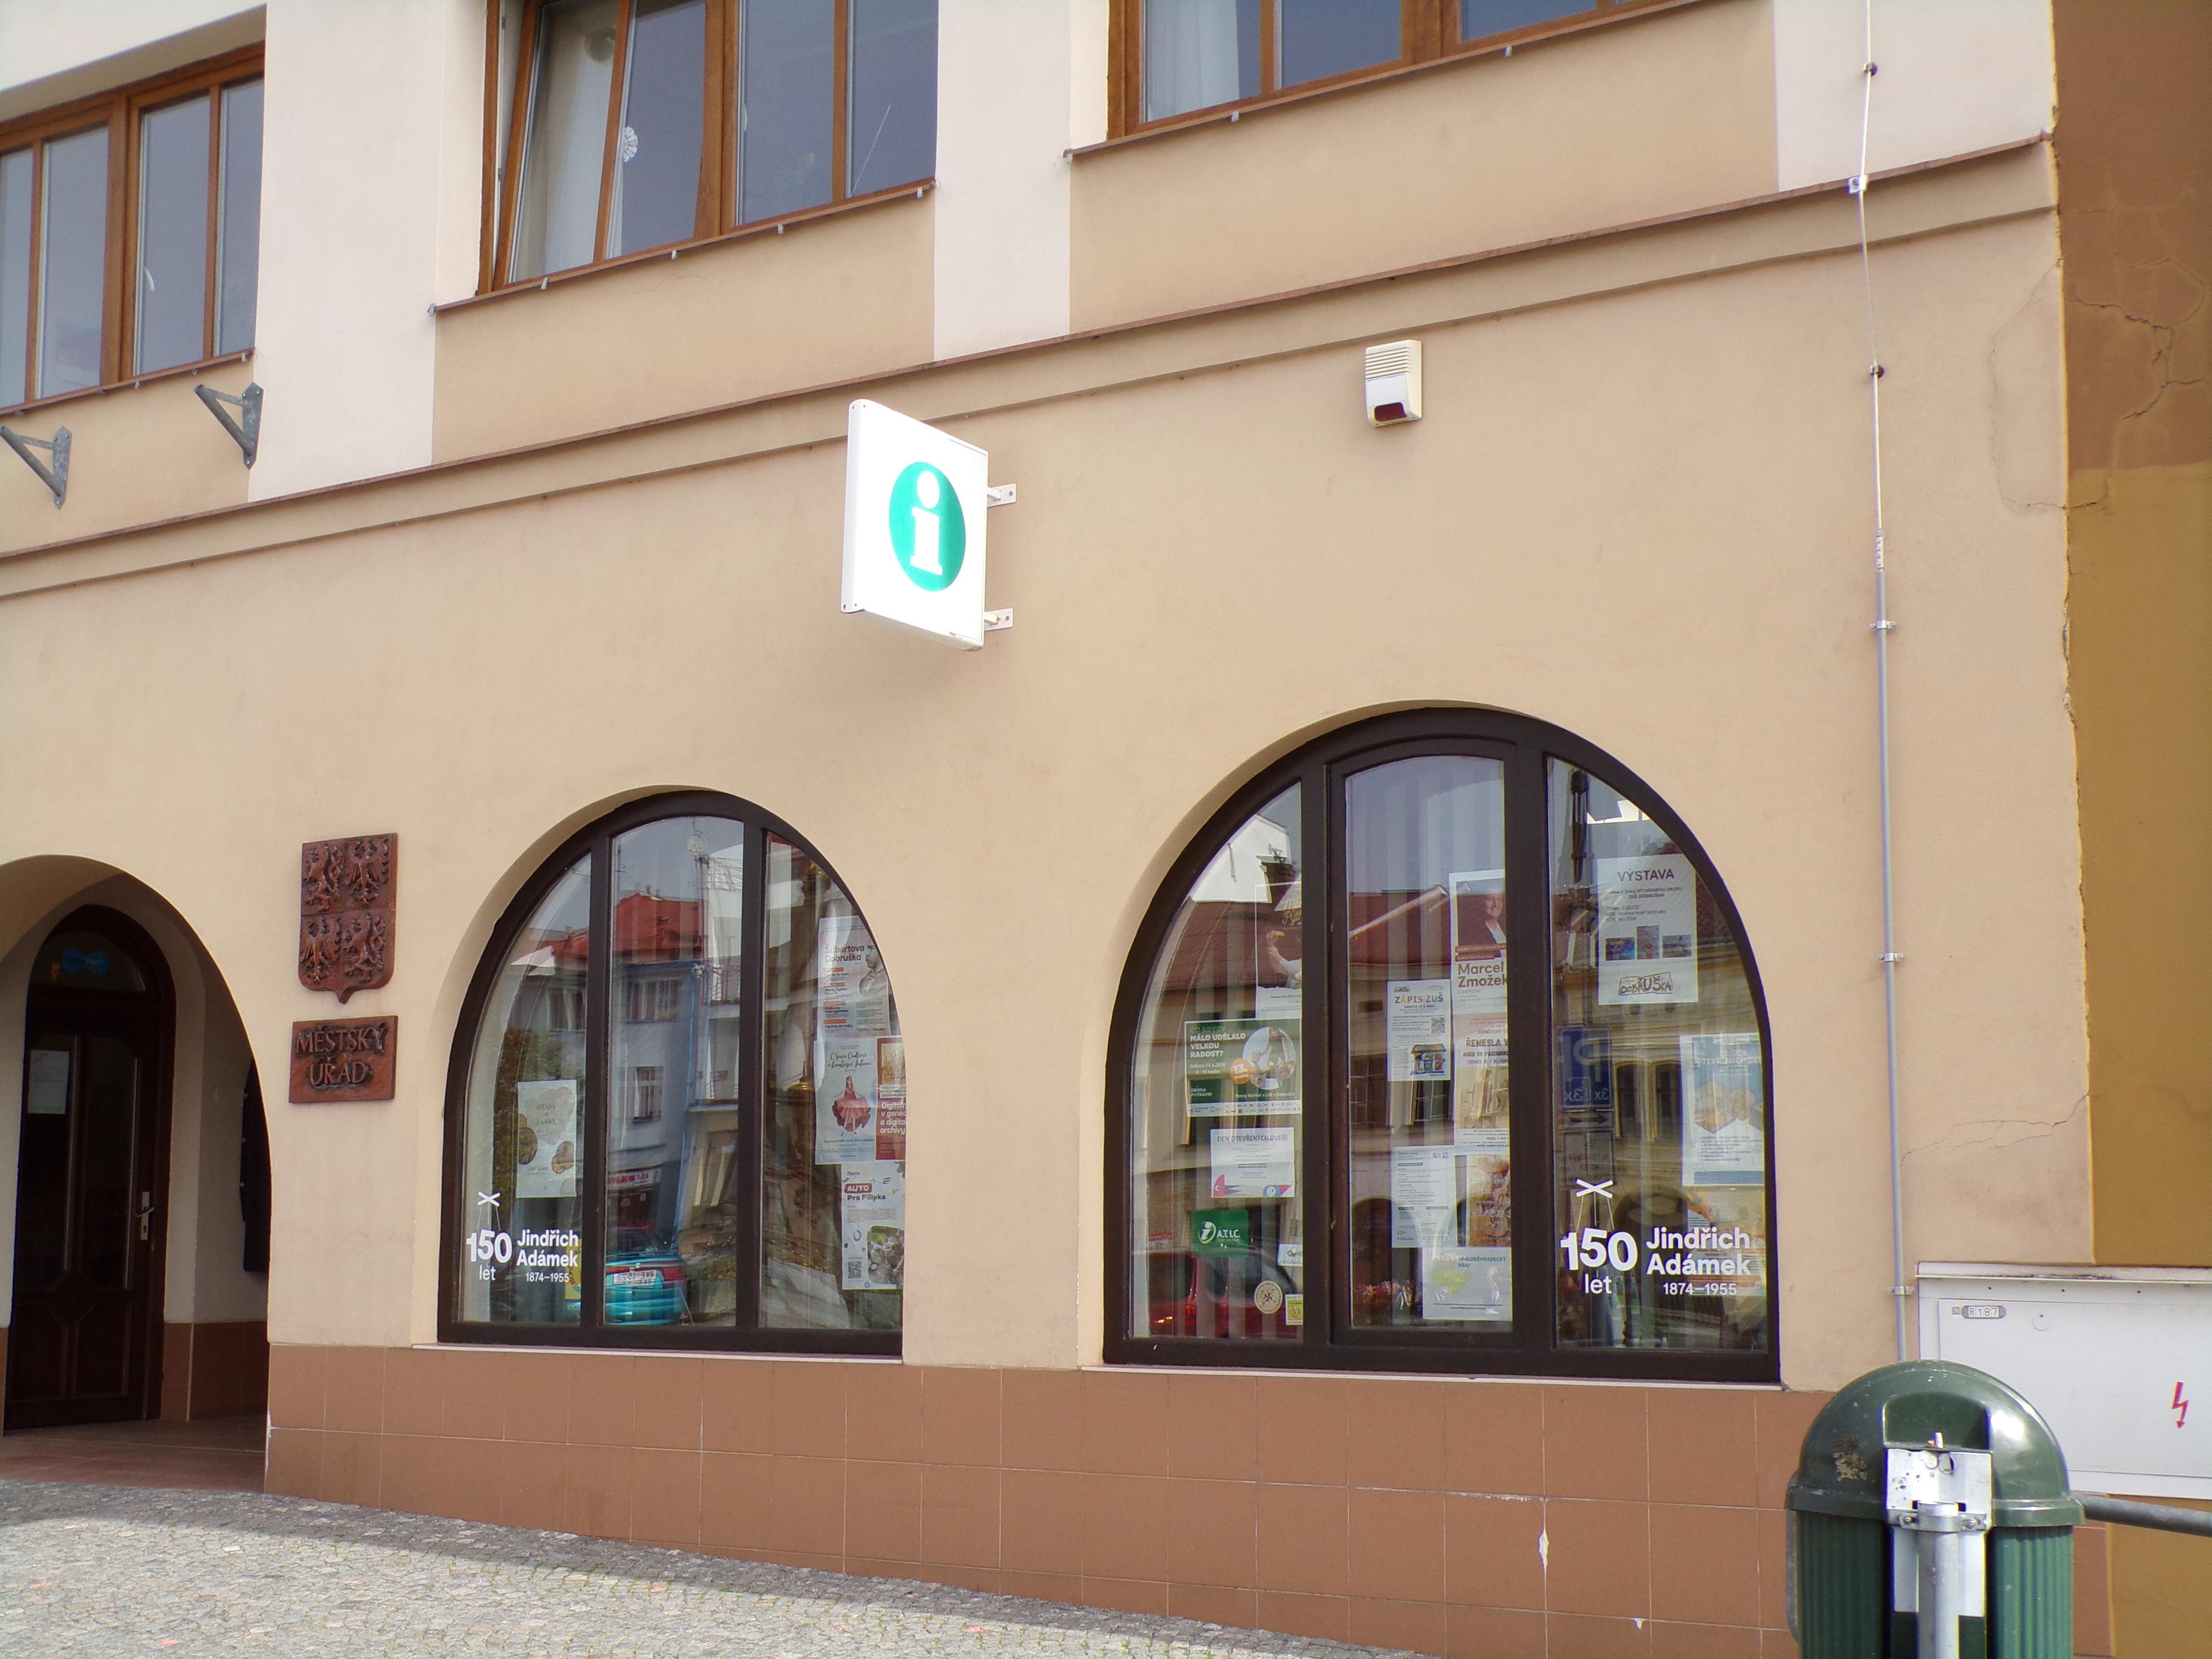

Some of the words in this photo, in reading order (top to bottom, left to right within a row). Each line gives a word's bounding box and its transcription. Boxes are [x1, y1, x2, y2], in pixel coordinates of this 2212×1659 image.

[1618, 868, 1674, 881] VÝSTAVA
[1458, 961, 1504, 975] Marcel
[1395, 993, 1423, 1004] ZÁPIS
[1426, 993, 1443, 1003] ZUŠ
[1212, 1032, 1245, 1041] UDĚLALO
[1466, 1037, 1501, 1047] ŘEMESLA
[466, 1229, 512, 1263] 150
[517, 1229, 578, 1246] Jindřich
[1646, 1227, 1750, 1249] Jindřich
[1561, 1227, 1638, 1271] 150
[517, 1249, 578, 1267] Adámek
[1646, 1253, 1751, 1276] Adámek
[479, 1265, 496, 1280] let
[1584, 1274, 1612, 1294] let
